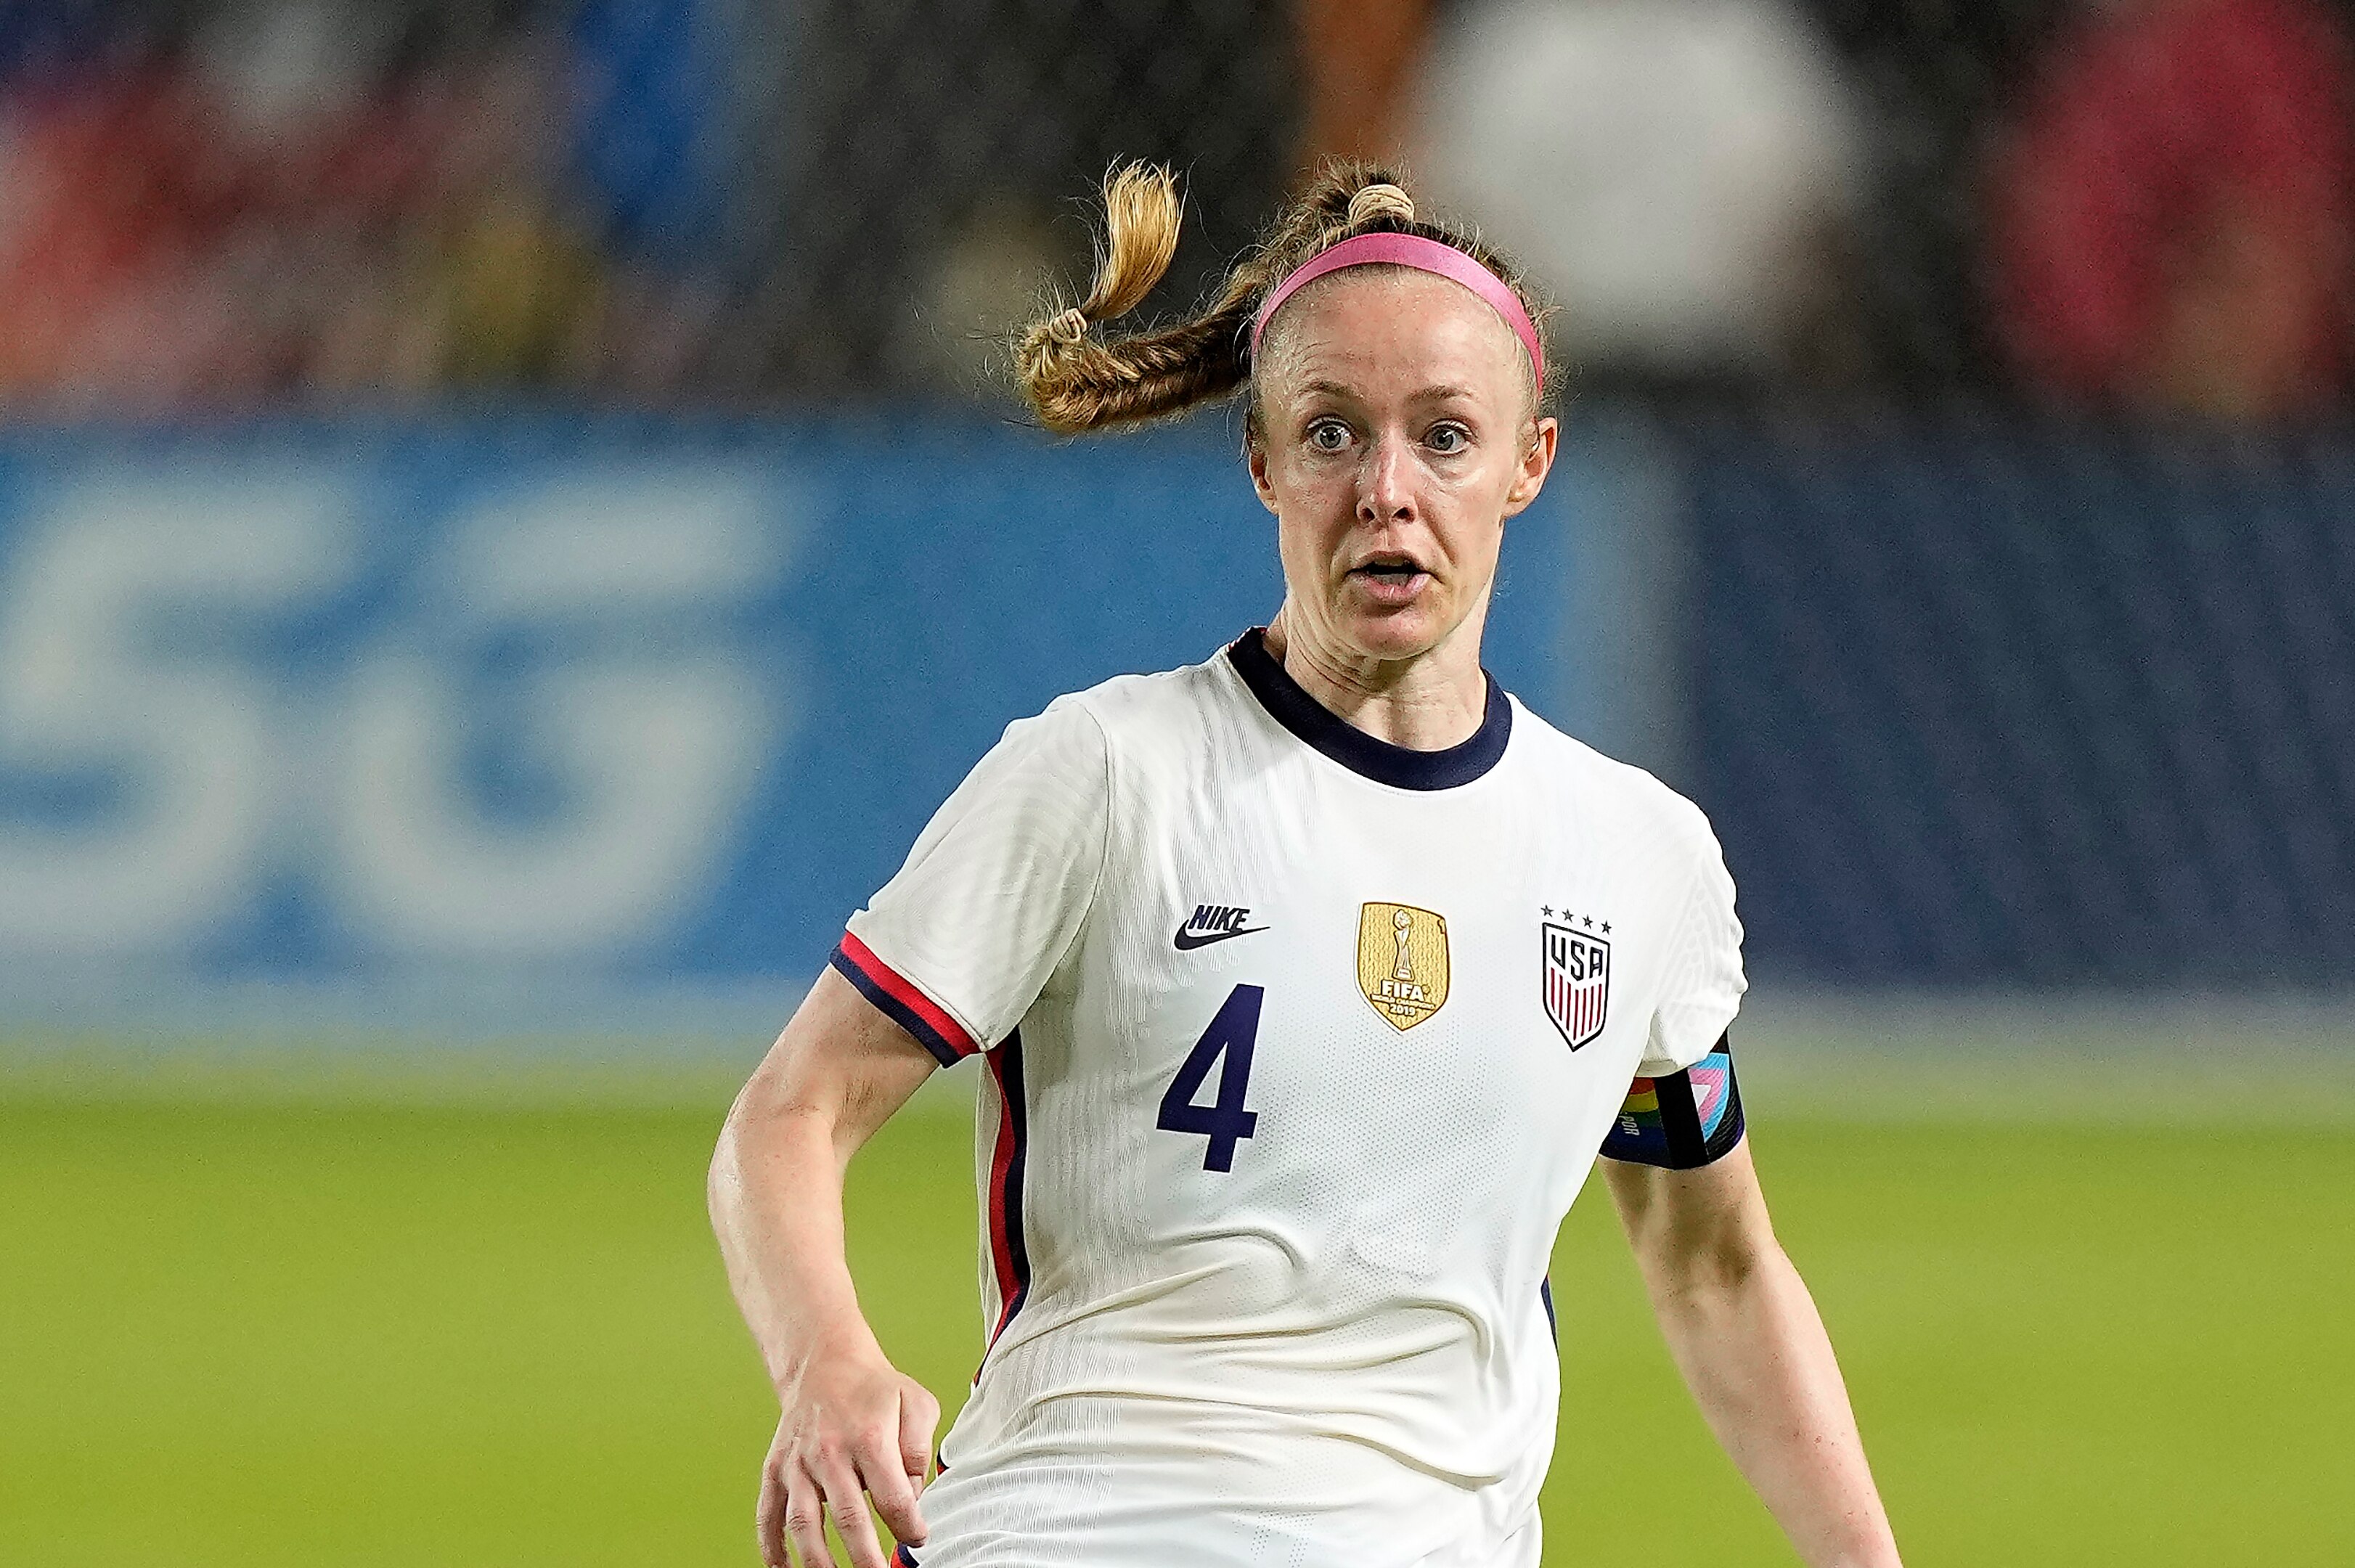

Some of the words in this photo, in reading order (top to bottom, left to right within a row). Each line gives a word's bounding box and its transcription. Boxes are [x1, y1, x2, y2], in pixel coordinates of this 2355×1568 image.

[1188, 905, 1250, 932] NIKE
[1551, 934, 1603, 981] USA
[1381, 980, 1425, 1002] FIFA
[1389, 1004, 1416, 1016] 2019
[1156, 983, 1265, 1173] 4
